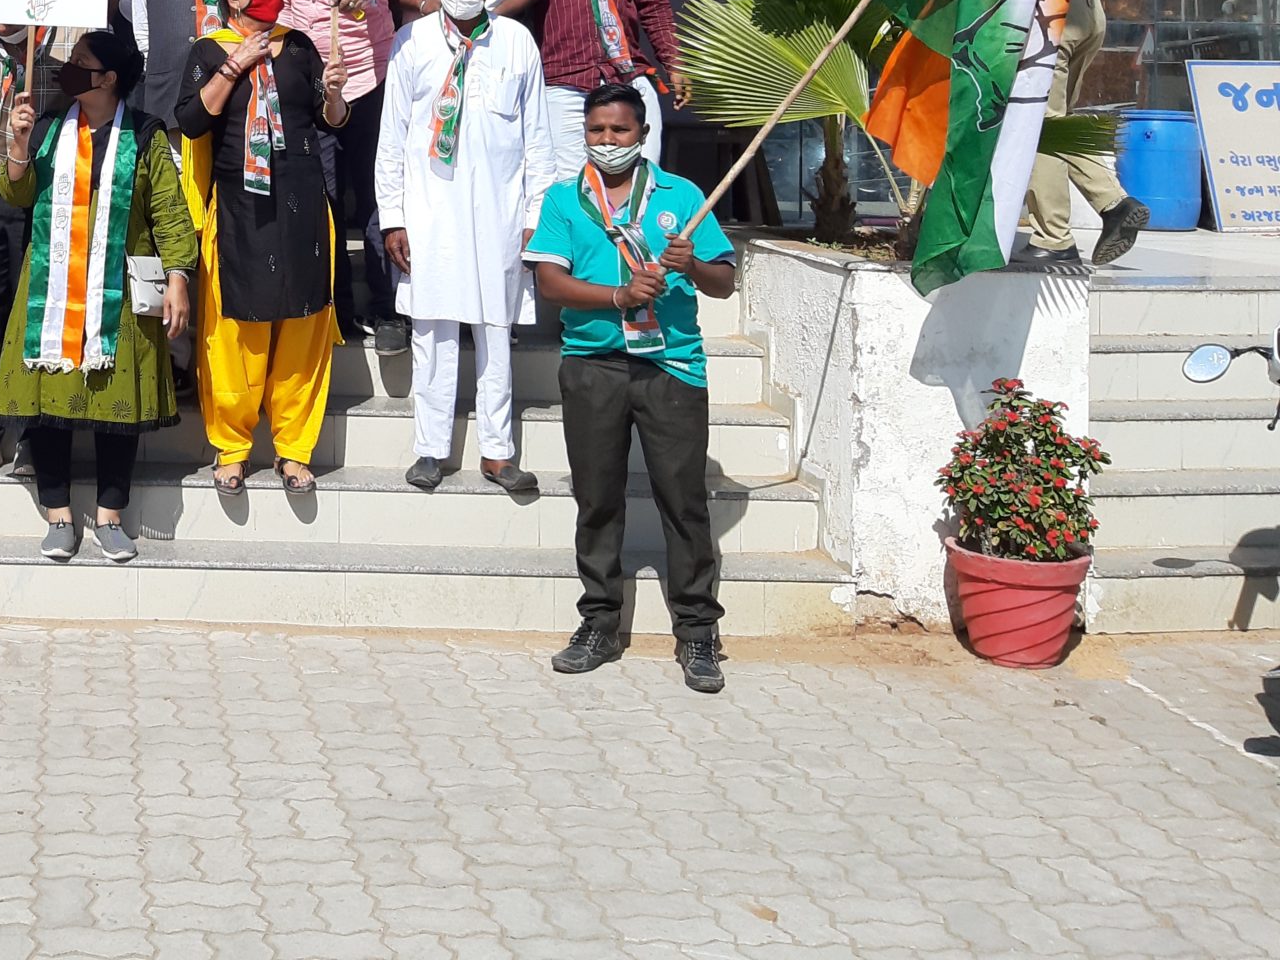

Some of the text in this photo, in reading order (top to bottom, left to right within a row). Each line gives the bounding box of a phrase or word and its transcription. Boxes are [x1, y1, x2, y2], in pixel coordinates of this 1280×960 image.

[1229, 150, 1280, 172] વેરા વસુ
[1235, 185, 1265, 197] જન્મ
[1241, 210, 1280, 222] અરજદ
